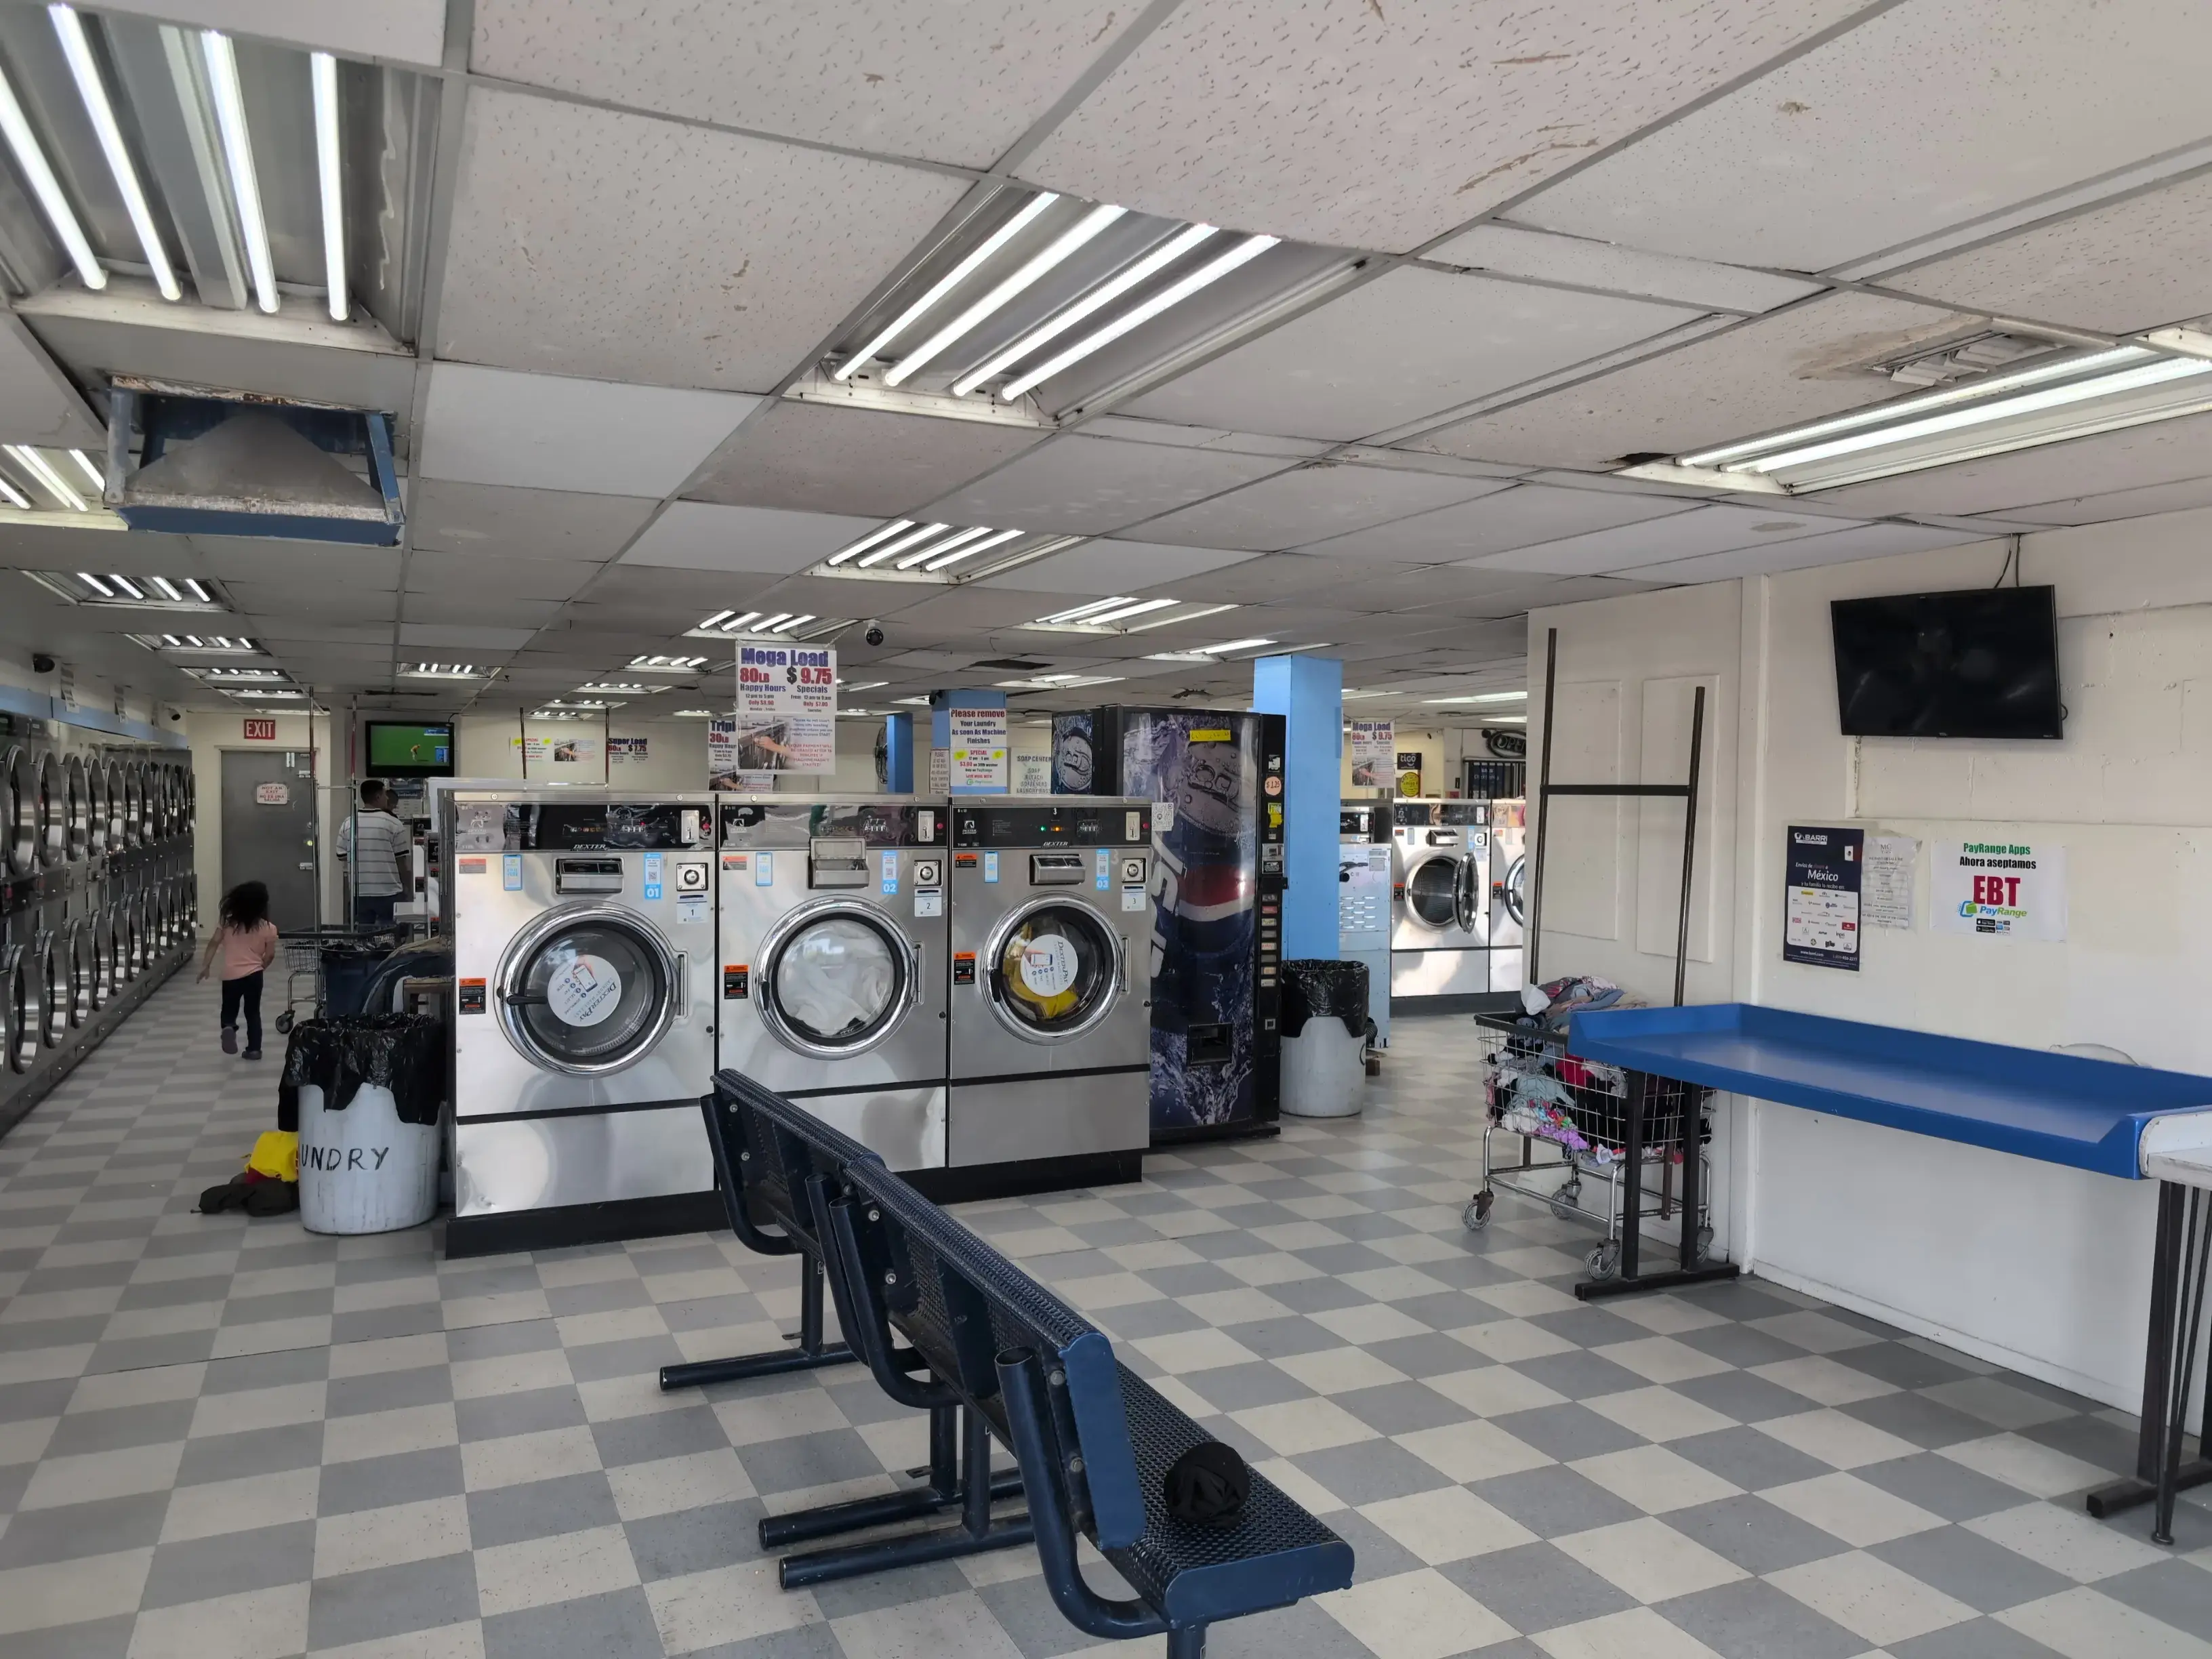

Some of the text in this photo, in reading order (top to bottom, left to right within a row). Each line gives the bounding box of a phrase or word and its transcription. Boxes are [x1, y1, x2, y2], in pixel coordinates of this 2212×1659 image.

[741, 648, 828, 668] Mega Load
[740, 666, 832, 684] 80LB $ 9.75
[740, 684, 763, 692] Happy
[797, 685, 827, 693] Specials
[246, 721, 273, 737] EXIT
[710, 720, 736, 733] Tripl
[1374, 722, 1391, 731] Load
[1400, 754, 1416, 766] tigo
[1963, 842, 2030, 855] PayRange Apps
[1960, 856, 2036, 869] Ahora aseptamos
[1807, 869, 1839, 882] México
[647, 888, 659, 898] 01
[883, 884, 896, 893] 02
[1973, 876, 2021, 907] EBT
[1980, 905, 2027, 918] PayRange
[299, 1143, 389, 1171] UNDRY
